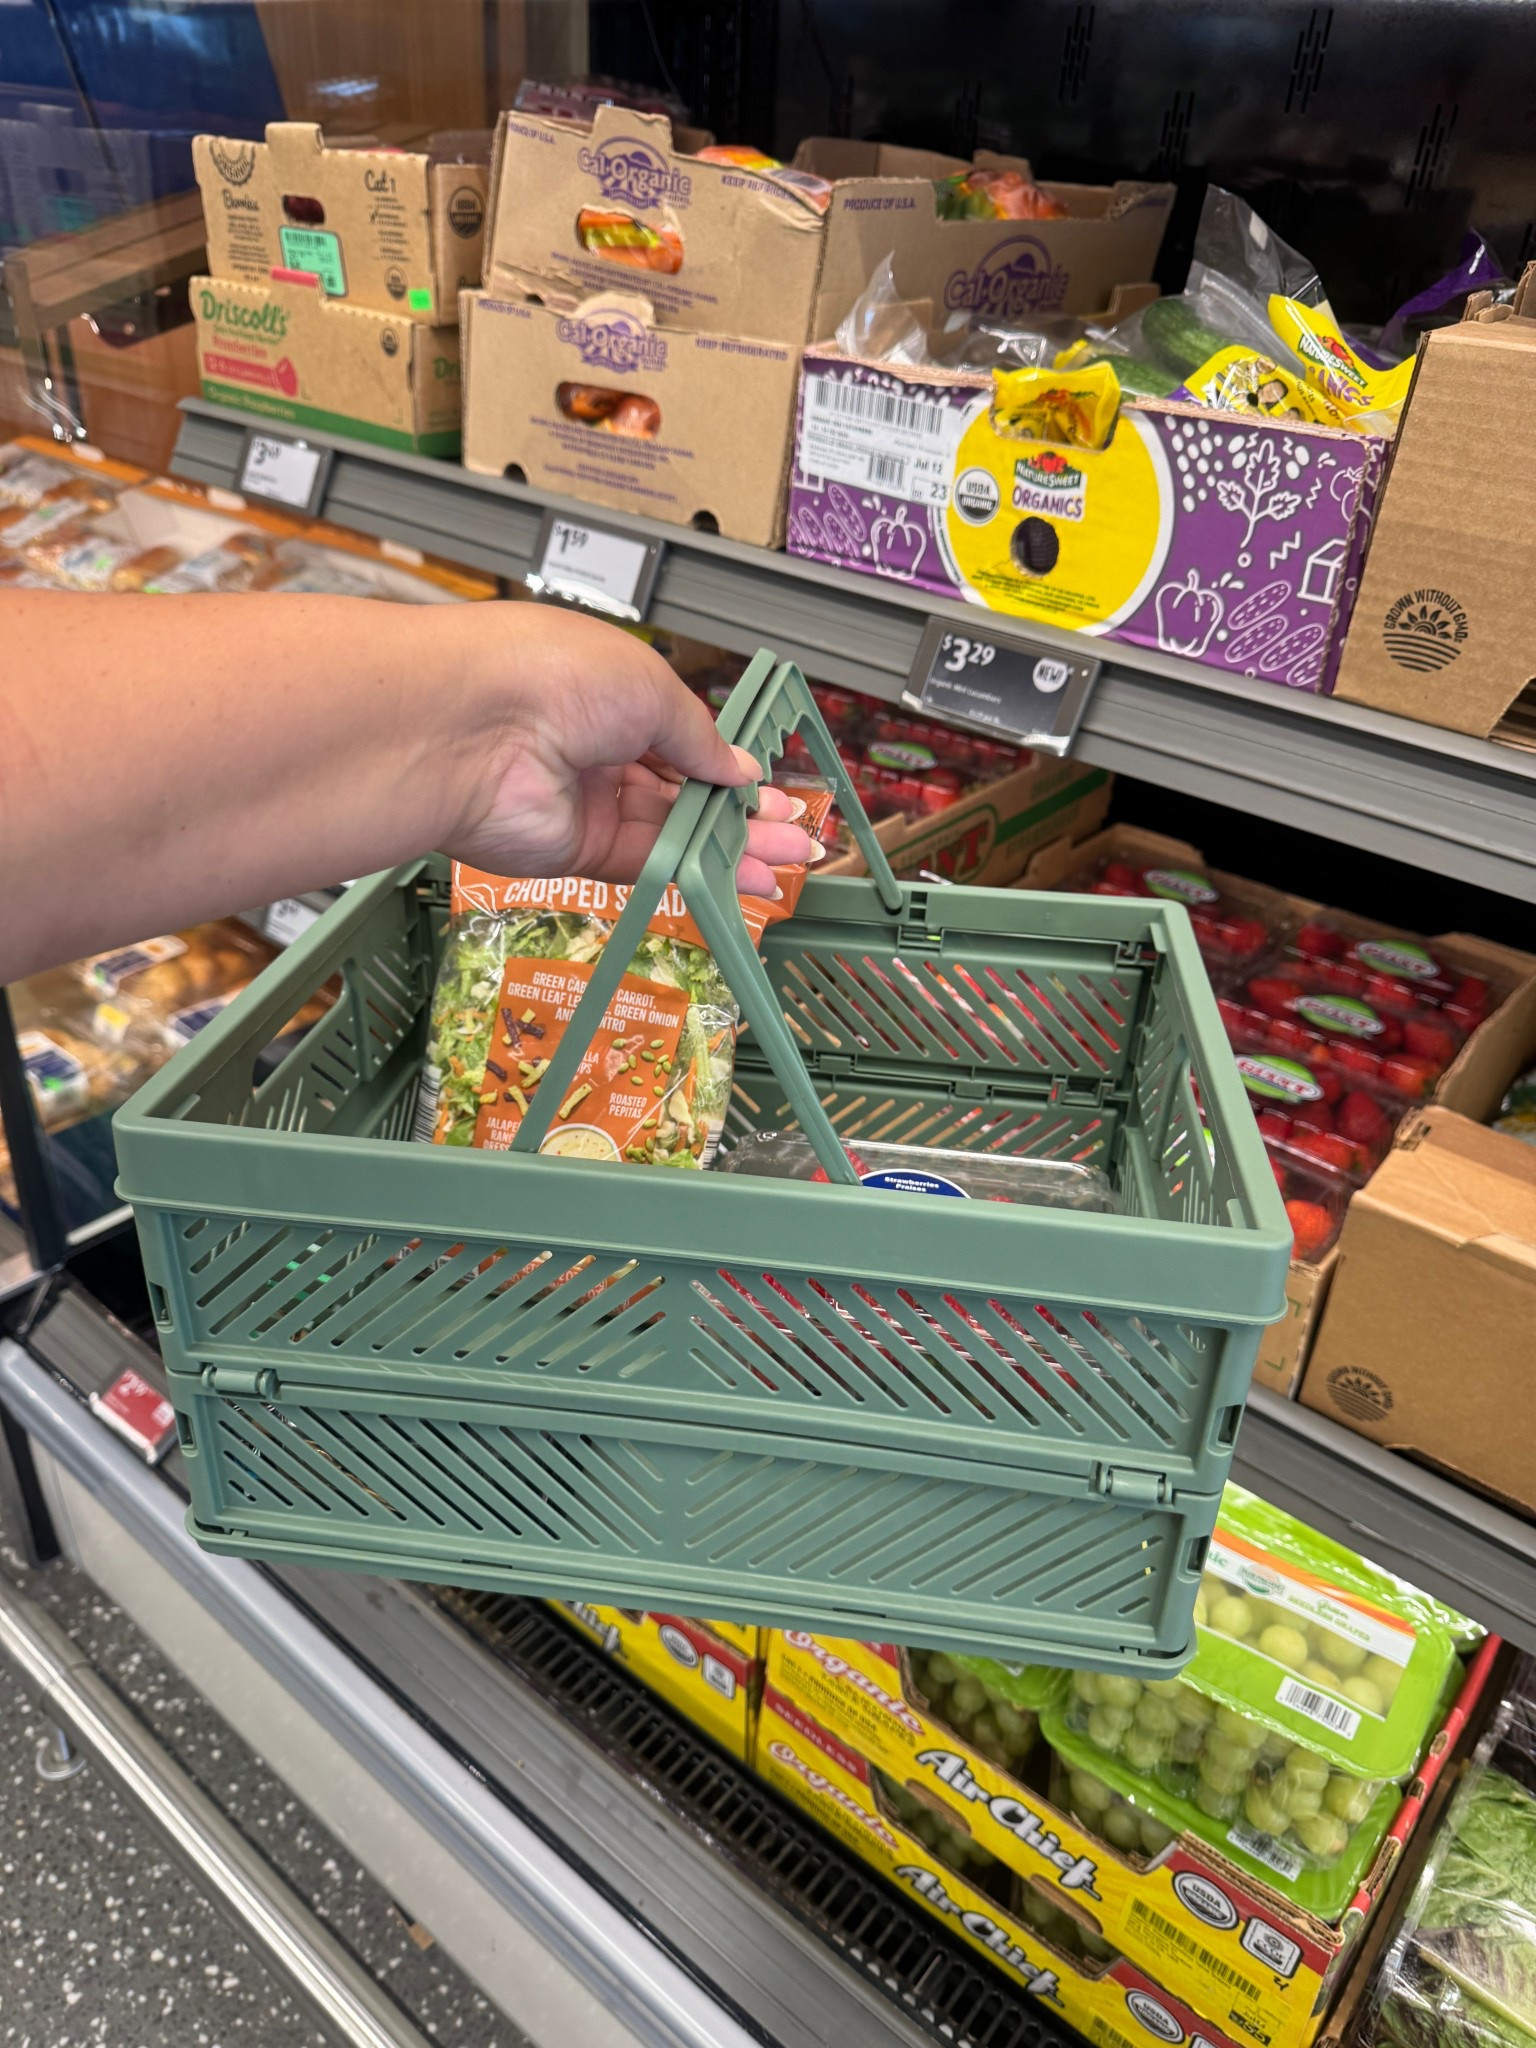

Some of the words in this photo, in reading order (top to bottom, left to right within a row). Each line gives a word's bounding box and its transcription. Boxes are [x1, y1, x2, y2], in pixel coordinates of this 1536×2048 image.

[844, 198, 882, 210] PRODUCE
[883, 198, 894, 210] OF
[199, 290, 287, 336] Driscoll's
[931, 483, 947, 499] 23
[966, 481, 989, 495] USDA
[1013, 486, 1083, 518] ORGANICS
[1384, 593, 1414, 630] GROWN
[1414, 589, 1462, 615] WITHOUT
[504, 877, 607, 909] CHOPPED
[615, 884, 687, 918] SAD
[533, 972, 564, 989] GREEN
[507, 982, 539, 999] GREEN
[542, 990, 566, 1003] LEAF
[614, 1005, 647, 1023] GREEN
[649, 1012, 680, 1029] ONION
[609, 1093, 647, 1108] ROASTED
[609, 1106, 642, 1119] PEPITAS
[490, 1130, 516, 1142] RANC
[884, 1176, 939, 1189] Strawberries
[895, 1183, 927, 1193] Fraises
[784, 1630, 925, 1736] Organic
[768, 1741, 899, 1850] Organic
[1192, 1883, 1221, 1909] USDA
[1143, 2001, 1169, 2026] USDA
